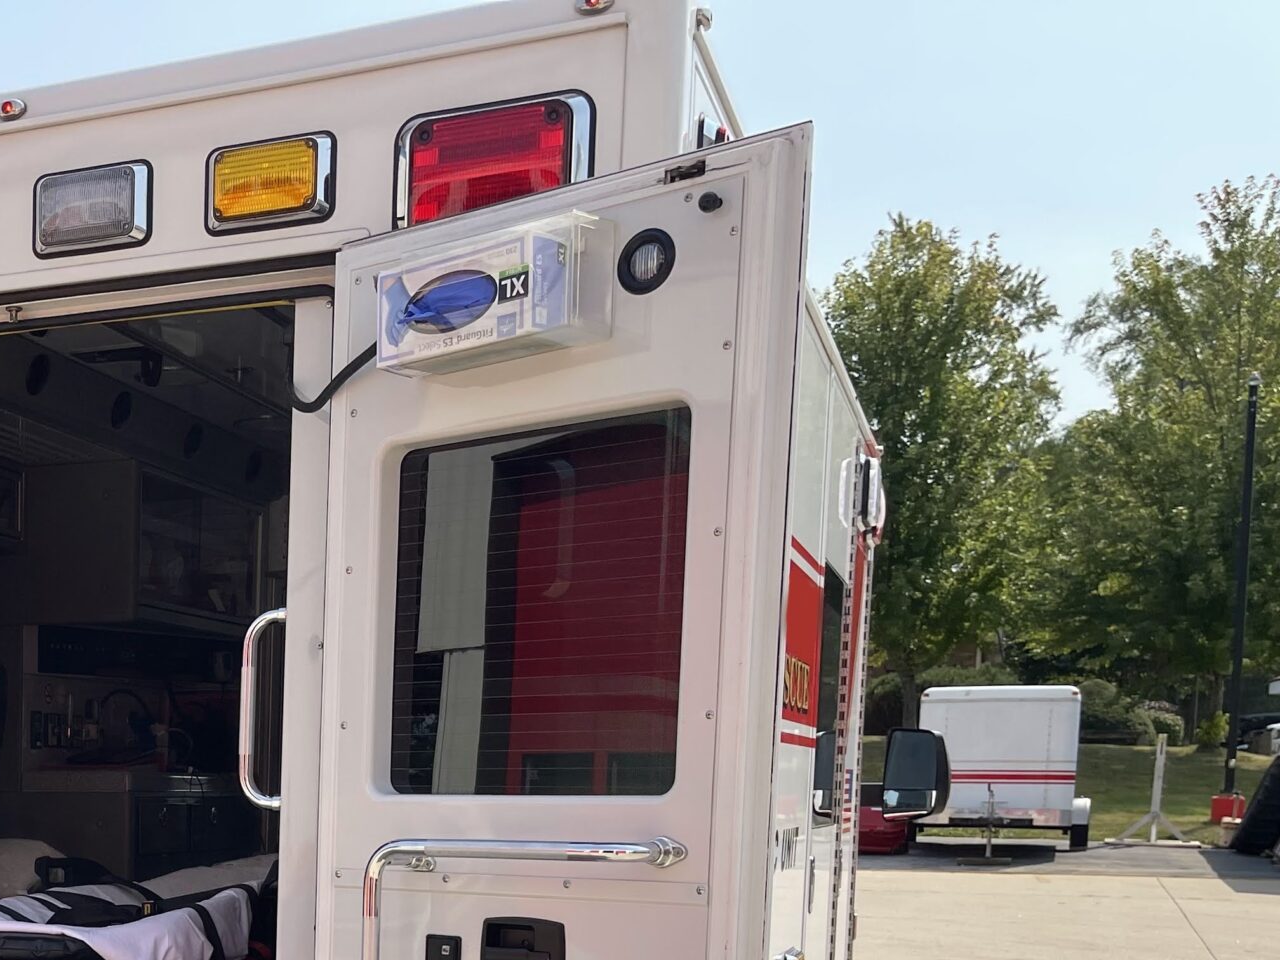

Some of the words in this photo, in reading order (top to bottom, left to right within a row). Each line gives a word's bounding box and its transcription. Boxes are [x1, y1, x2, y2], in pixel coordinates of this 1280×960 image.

[501, 275, 526, 298] XL
[442, 337, 454, 349] ES
[456, 327, 494, 345] FitGuard
